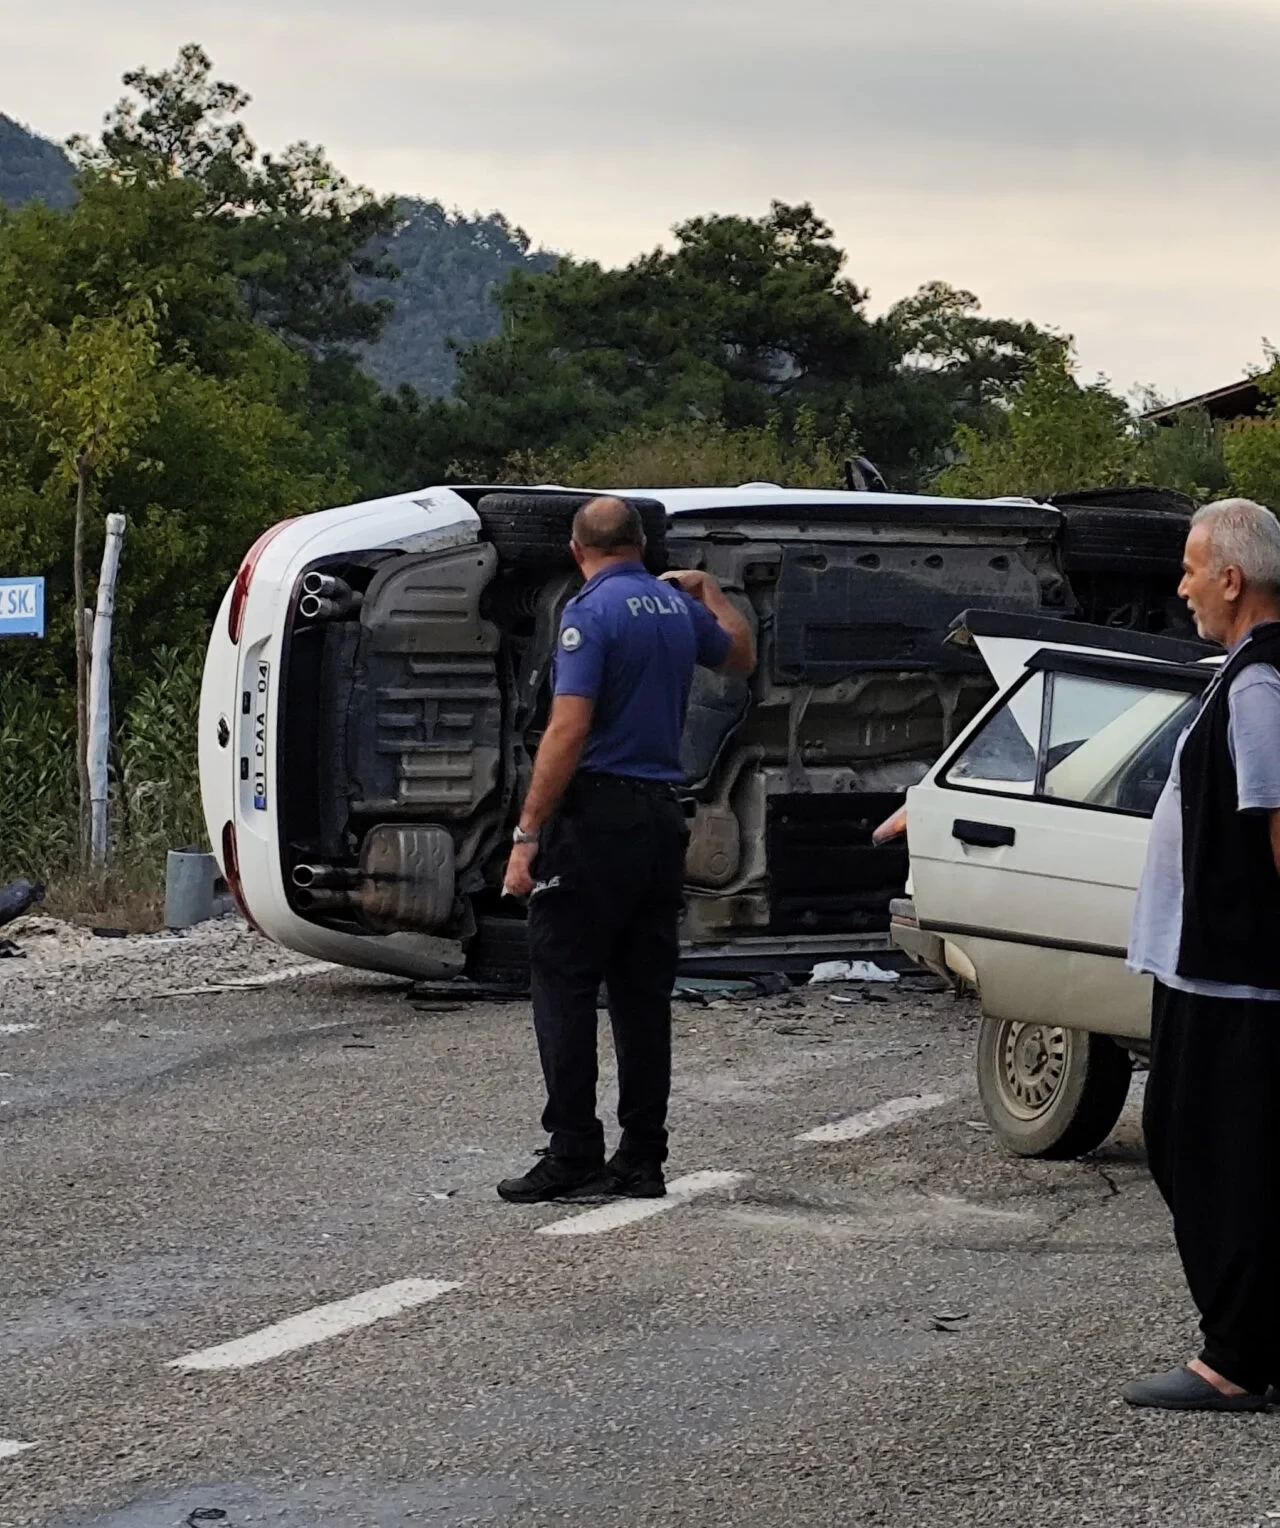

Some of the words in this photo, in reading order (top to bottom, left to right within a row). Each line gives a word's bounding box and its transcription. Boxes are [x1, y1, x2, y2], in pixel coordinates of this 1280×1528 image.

[8, 589, 34, 614] SK.
[257, 665, 268, 693] 04
[255, 713, 266, 757] CAA
[254, 771, 265, 796] 01
